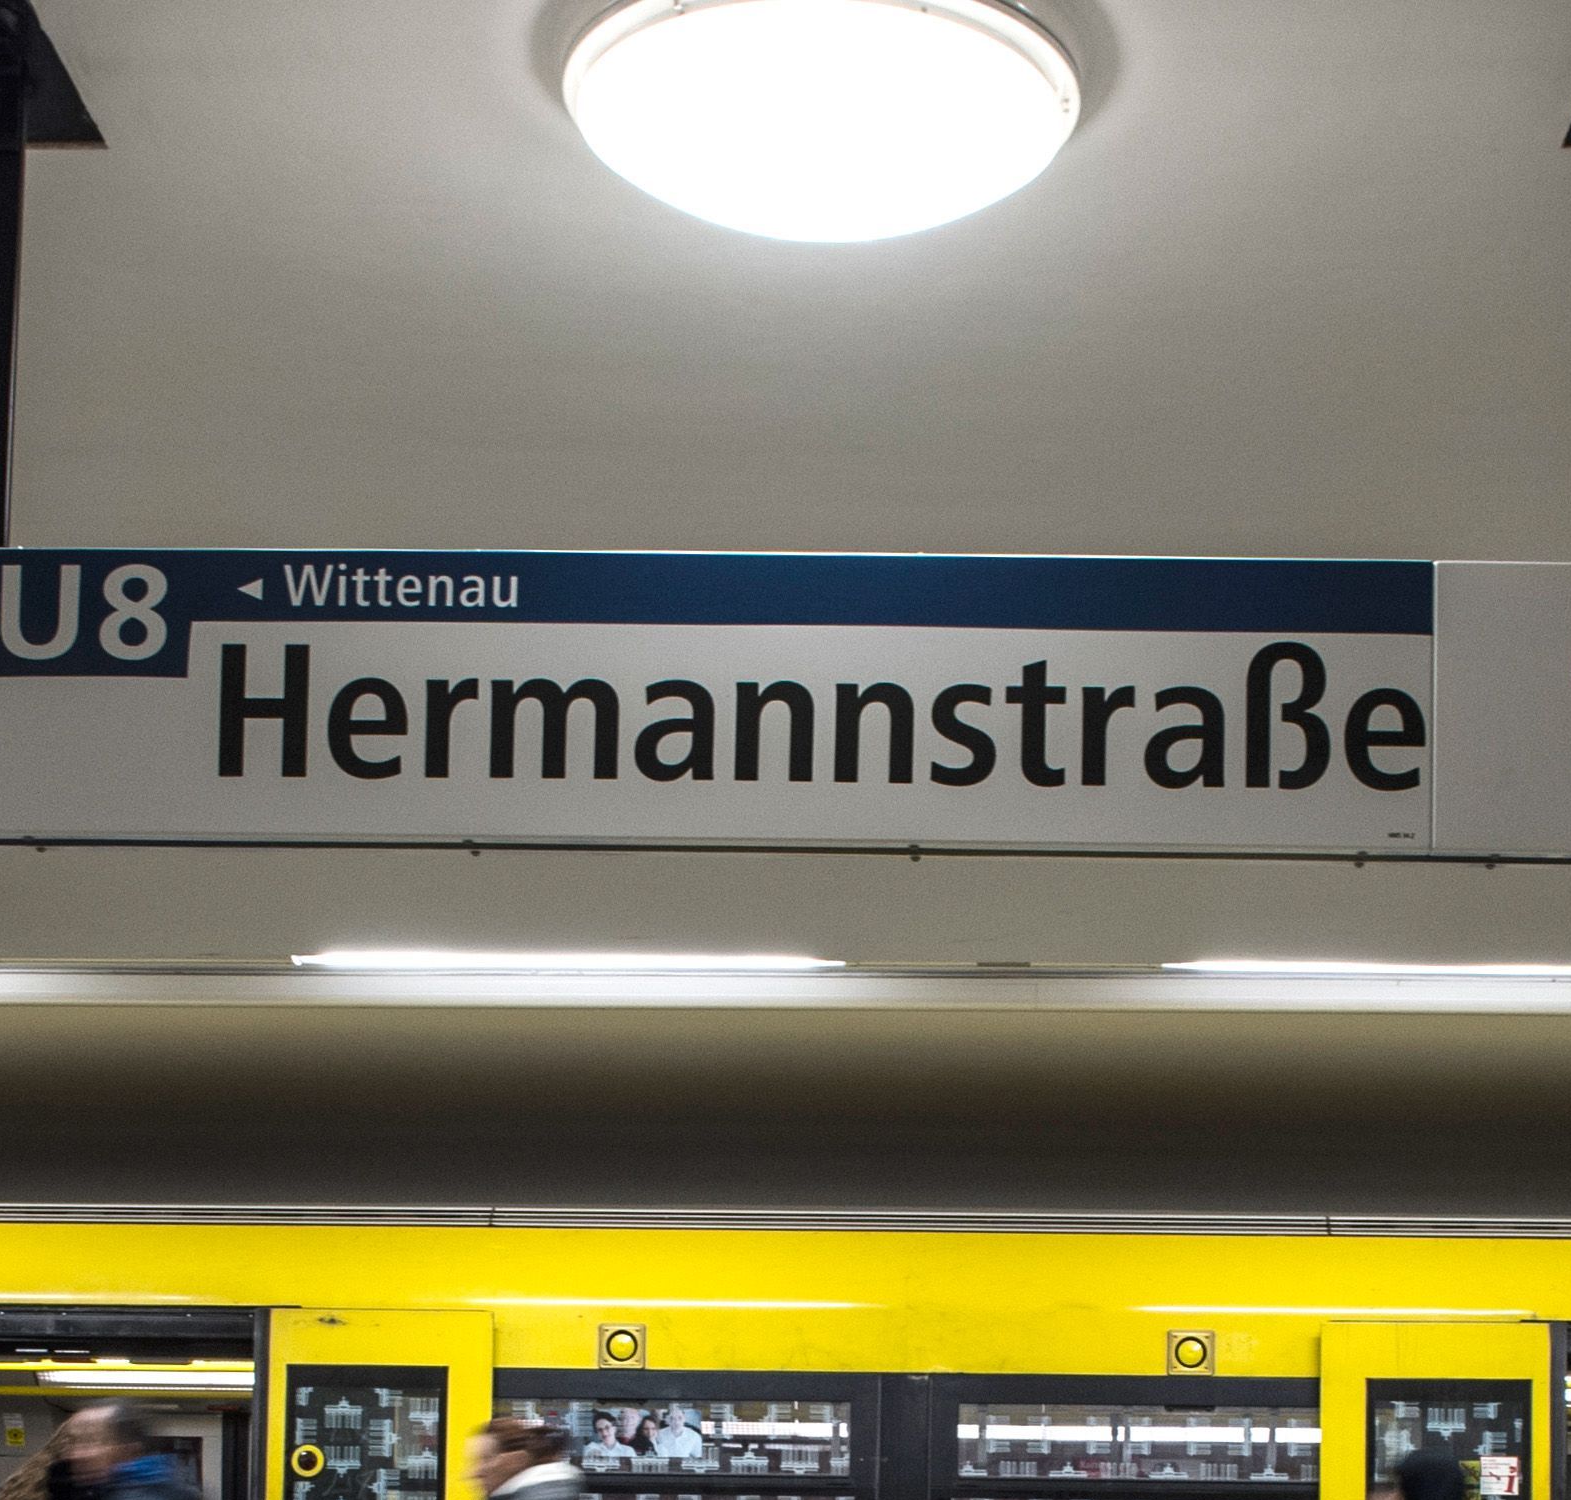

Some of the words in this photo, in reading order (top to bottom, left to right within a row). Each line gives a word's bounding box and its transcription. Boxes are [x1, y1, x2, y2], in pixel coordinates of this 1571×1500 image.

[0, 563, 169, 661] U8
[283, 563, 520, 608] Wittenau
[217, 640, 1427, 792] Hermannstraße
